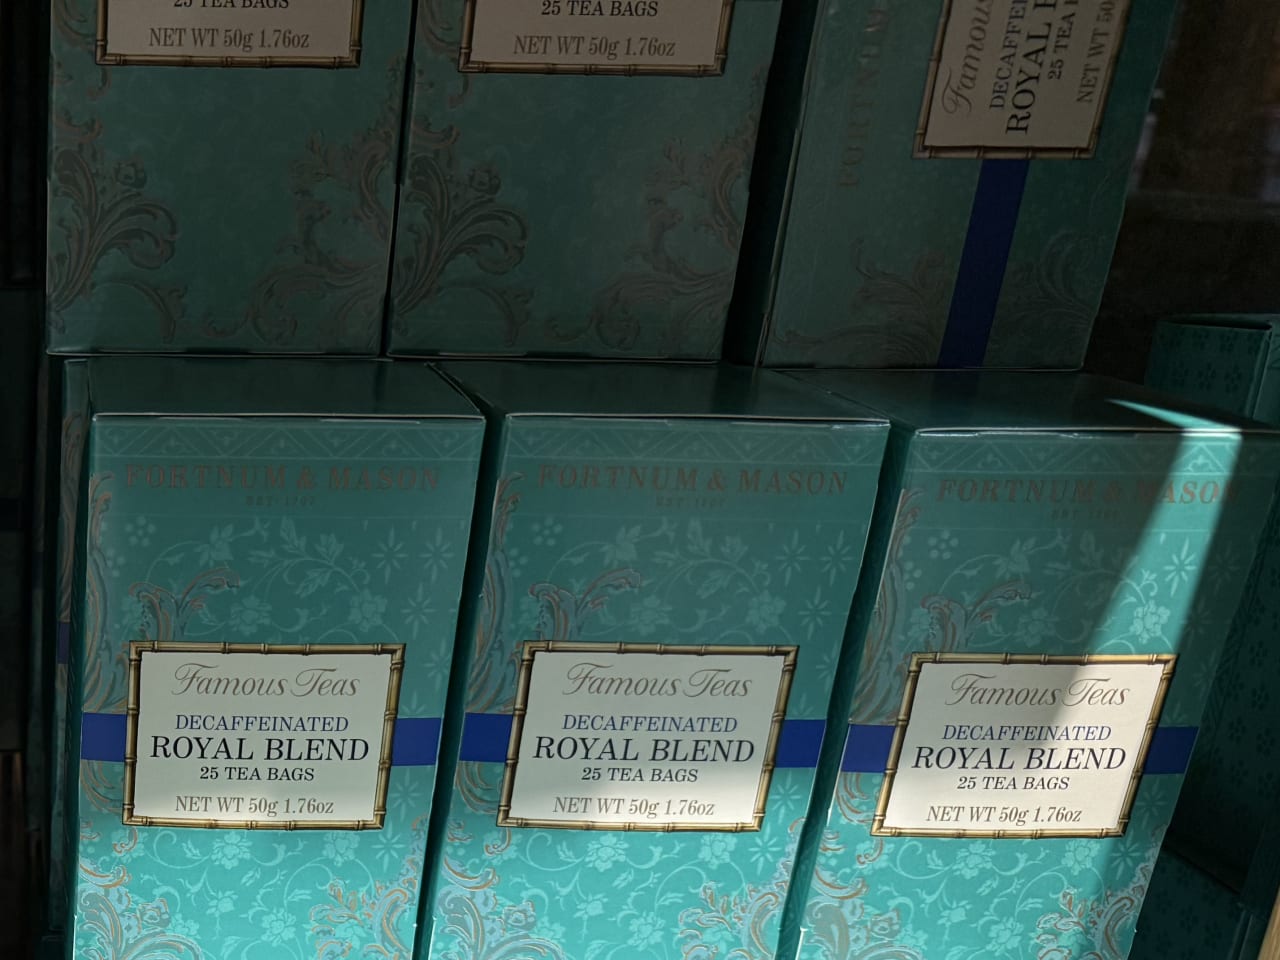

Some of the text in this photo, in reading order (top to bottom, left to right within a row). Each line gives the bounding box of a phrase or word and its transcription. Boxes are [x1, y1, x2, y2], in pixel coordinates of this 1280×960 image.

[541, 0, 658, 17] 25 TEA BAGS
[1006, 20, 1053, 134] ROYAL
[175, 714, 349, 732] DECAFFEINATED
[562, 714, 737, 733] DECAFFEINATED
[941, 725, 1111, 741] DECAFFEINATED
[150, 735, 369, 761] ROYAL BLEND
[533, 736, 754, 762] ROYAL BLEND
[911, 746, 1126, 770] ROYAL BLEND
[200, 766, 314, 781] 25 TEA BAGS
[581, 767, 698, 783] 25 TEA BAGS
[957, 776, 1070, 790] 25 TEA BAGS
